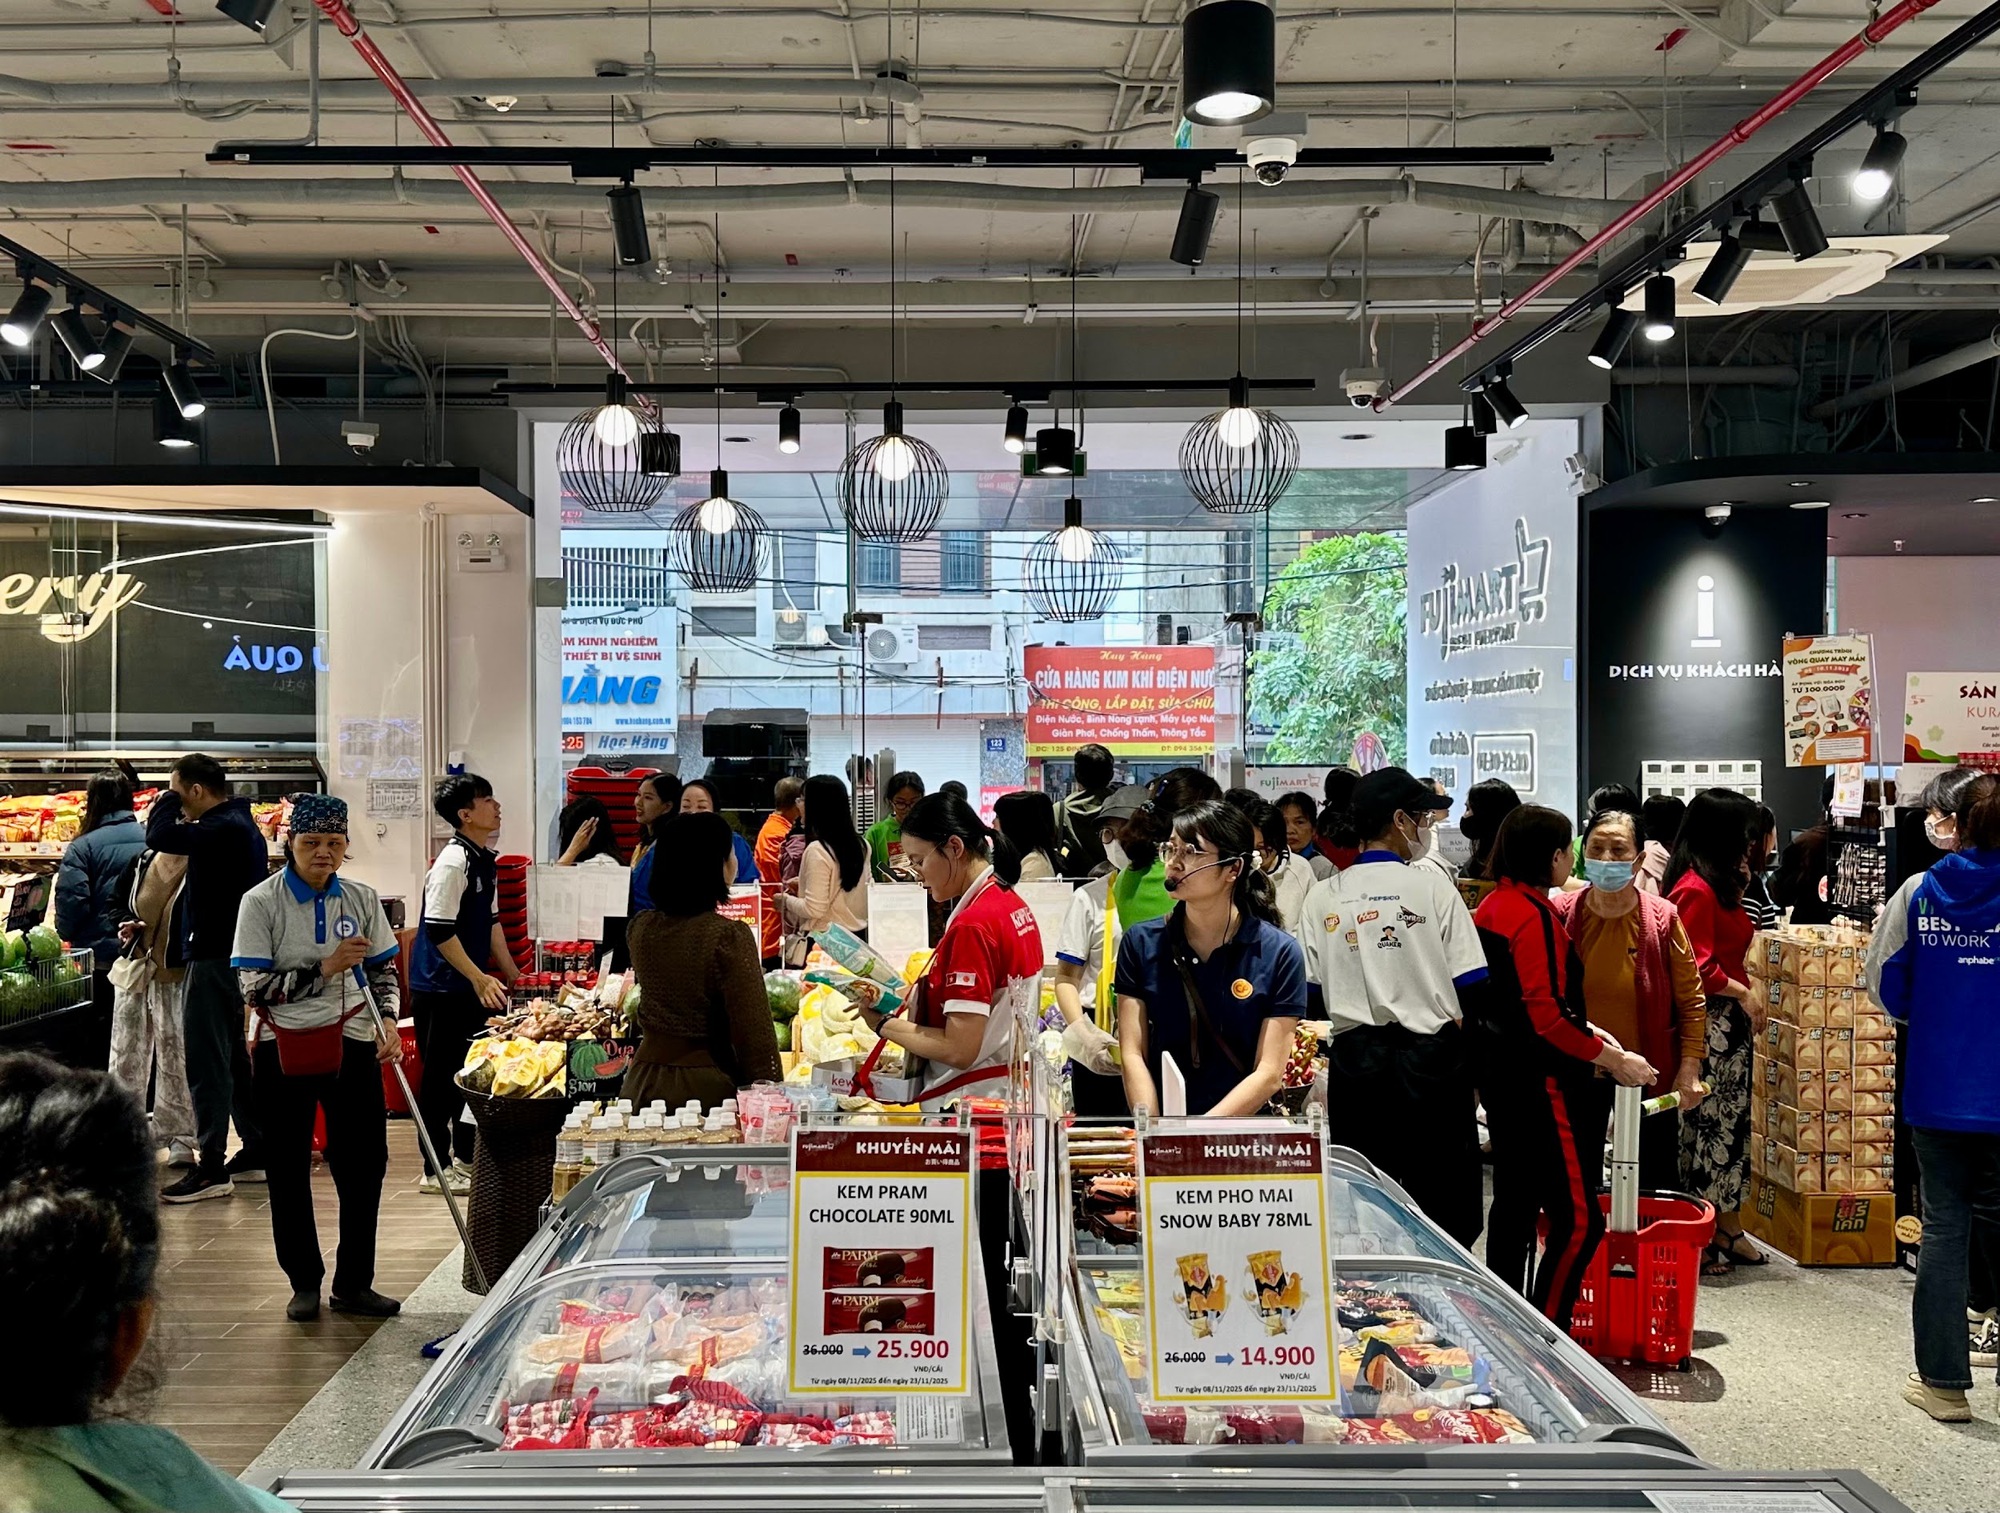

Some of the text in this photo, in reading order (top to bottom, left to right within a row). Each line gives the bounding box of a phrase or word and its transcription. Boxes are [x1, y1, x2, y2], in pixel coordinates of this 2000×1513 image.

[578, 638, 607, 646] KINH
[610, 636, 658, 647] NGHIỆM
[564, 649, 661, 662] THIẾT BỊ VỆ SINH
[1100, 651, 1124, 661] Huy
[1788, 657, 1808, 665] VÒNG
[1810, 656, 1829, 664] QUAY
[1609, 665, 1654, 681] DỊCH
[1657, 665, 1683, 681] VỤ
[1687, 661, 1751, 677] KHÁCH
[1036, 665, 1061, 688] CỬA
[1065, 666, 1100, 688] HÀNG
[1103, 670, 1128, 688] KIM
[1132, 666, 1153, 688] KHÍ
[1157, 666, 1188, 692] ĐIỆN
[1959, 681, 1997, 699] SẢN
[1105, 694, 1128, 709] LẮP
[1160, 714, 1179, 725] Máy
[1182, 714, 1197, 725] Lọc
[1052, 728, 1073, 738] Giàn
[1100, 727, 1130, 739] Chống
[1132, 727, 1158, 738] Thấm,
[1160, 727, 1188, 738] Thông
[1190, 726, 1206, 737] Tắc
[598, 736, 627, 751] Học
[1397, 911, 1426, 924] Doritos
[1918, 917, 1960, 932] BES
[1377, 941, 1402, 949] QUAKER
[1919, 933, 1990, 948] TO WORK
[856, 1137, 923, 1155] KHUYẾN
[928, 1141, 960, 1155] MÃI
[1204, 1140, 1273, 1157] KHUYẾN
[1278, 1142, 1311, 1156] MÃI
[837, 1185, 927, 1199] KEM PRAM
[1177, 1189, 1292, 1204] KEM PHO MAI
[810, 1209, 954, 1223] CHOCOLATE 90ML
[1160, 1213, 1312, 1228] SNOW BABY 78ML
[842, 1251, 878, 1260] PARM
[843, 1296, 879, 1305] PARM
[803, 1340, 949, 1358] 36.000 25.900
[1165, 1347, 1315, 1365] 26.000 14.900
[914, 1365, 943, 1373] VNĐ/CÁI
